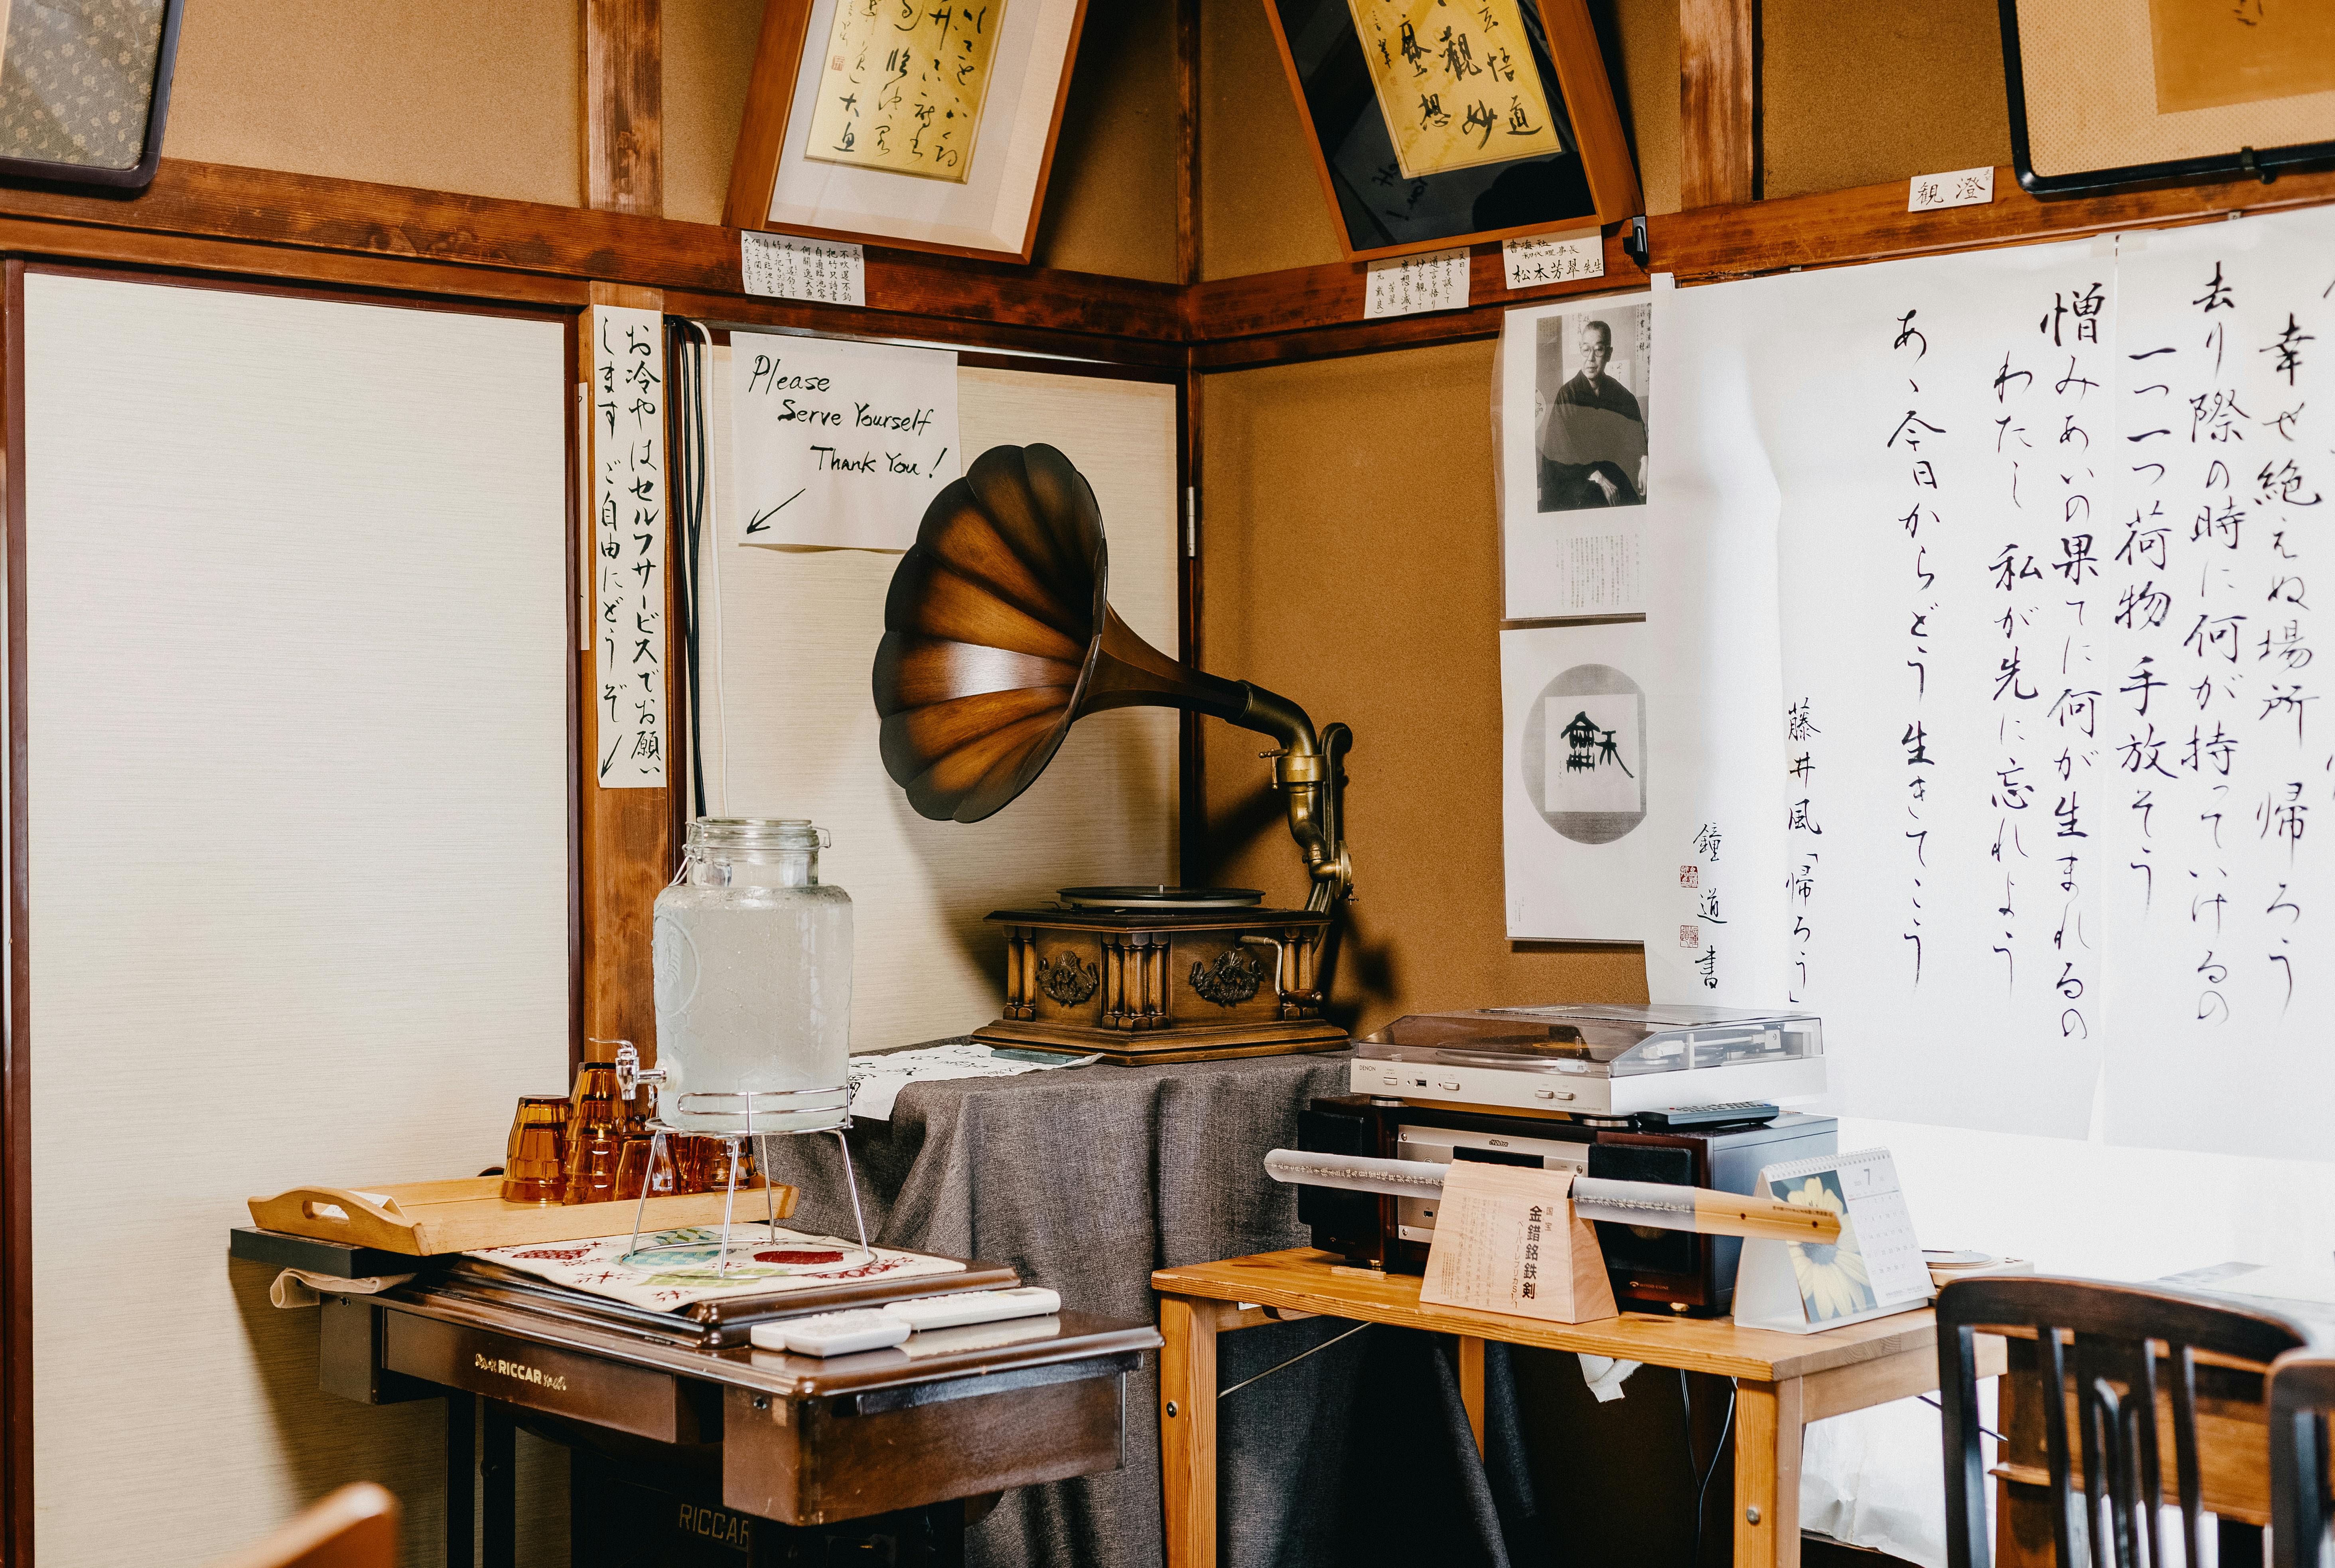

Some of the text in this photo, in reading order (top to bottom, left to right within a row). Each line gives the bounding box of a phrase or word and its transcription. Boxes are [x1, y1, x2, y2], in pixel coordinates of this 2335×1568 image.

[1477, 0, 1542, 135] 玄悟道
[1584, 259, 1603, 274] 先生
[747, 354, 830, 395] Please
[777, 398, 935, 437] Serve Yourself
[809, 444, 877, 474] Thank
[2256, 781, 2309, 1015] 帰ろう
[1864, 1168, 1870, 1186] 7
[498, 1359, 542, 1385] RICCAR
